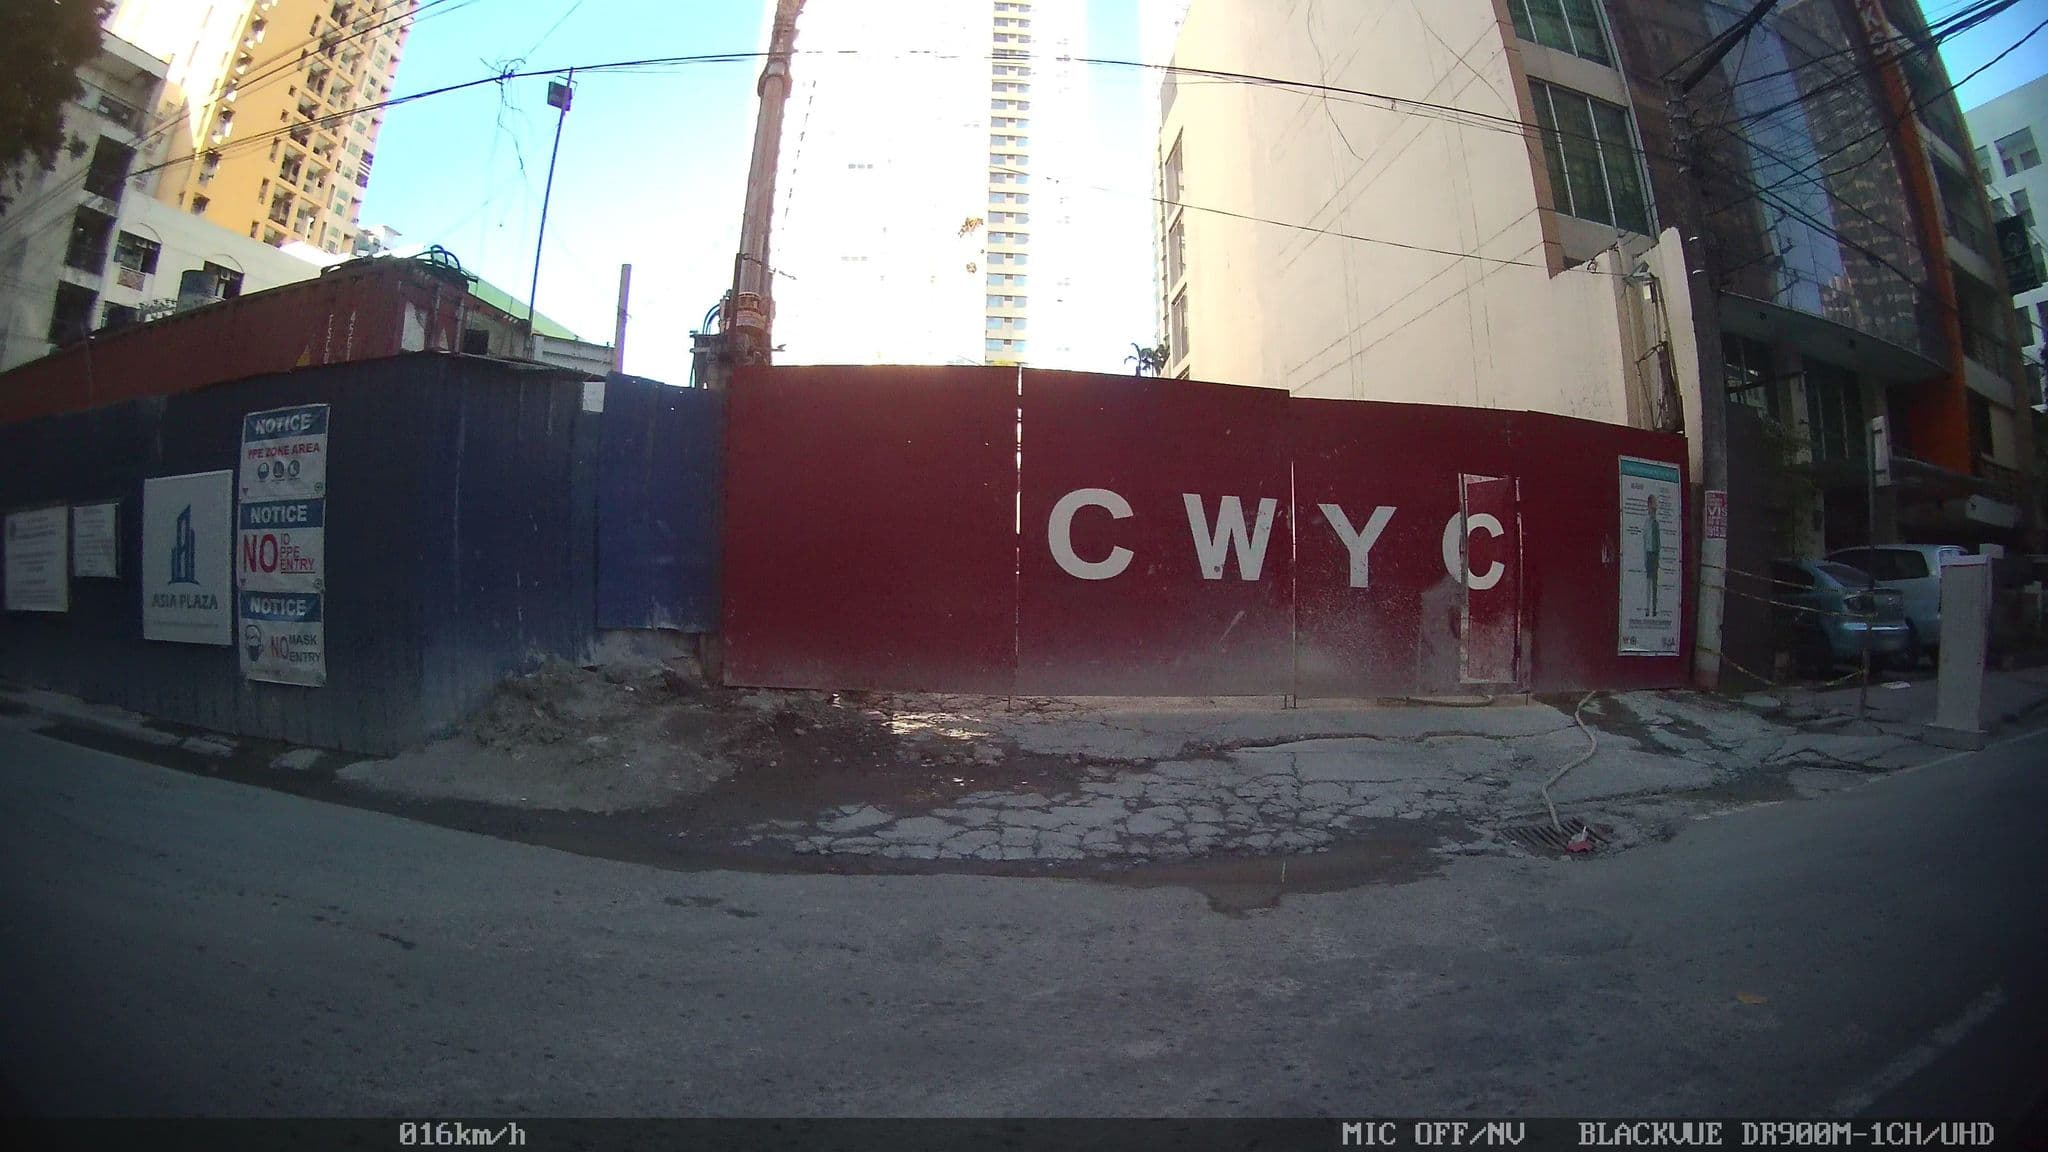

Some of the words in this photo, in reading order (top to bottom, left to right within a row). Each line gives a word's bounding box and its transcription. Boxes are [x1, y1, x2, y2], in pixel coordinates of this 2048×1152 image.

[255, 413, 313, 435] NOTICE
[266, 446, 289, 458] ZONE
[291, 443, 321, 455] AREA
[250, 505, 308, 524] NOTICE
[280, 533, 291, 546] ID
[243, 533, 279, 574] NO
[280, 546, 300, 559] PPE
[280, 559, 315, 571] ENTRY
[152, 594, 177, 609] ASIA
[180, 593, 218, 610] PLAZA
[250, 598, 306, 617] NOTICE
[270, 635, 289, 659] NO
[289, 634, 317, 647] MASK
[289, 651, 321, 664] ENTRY
